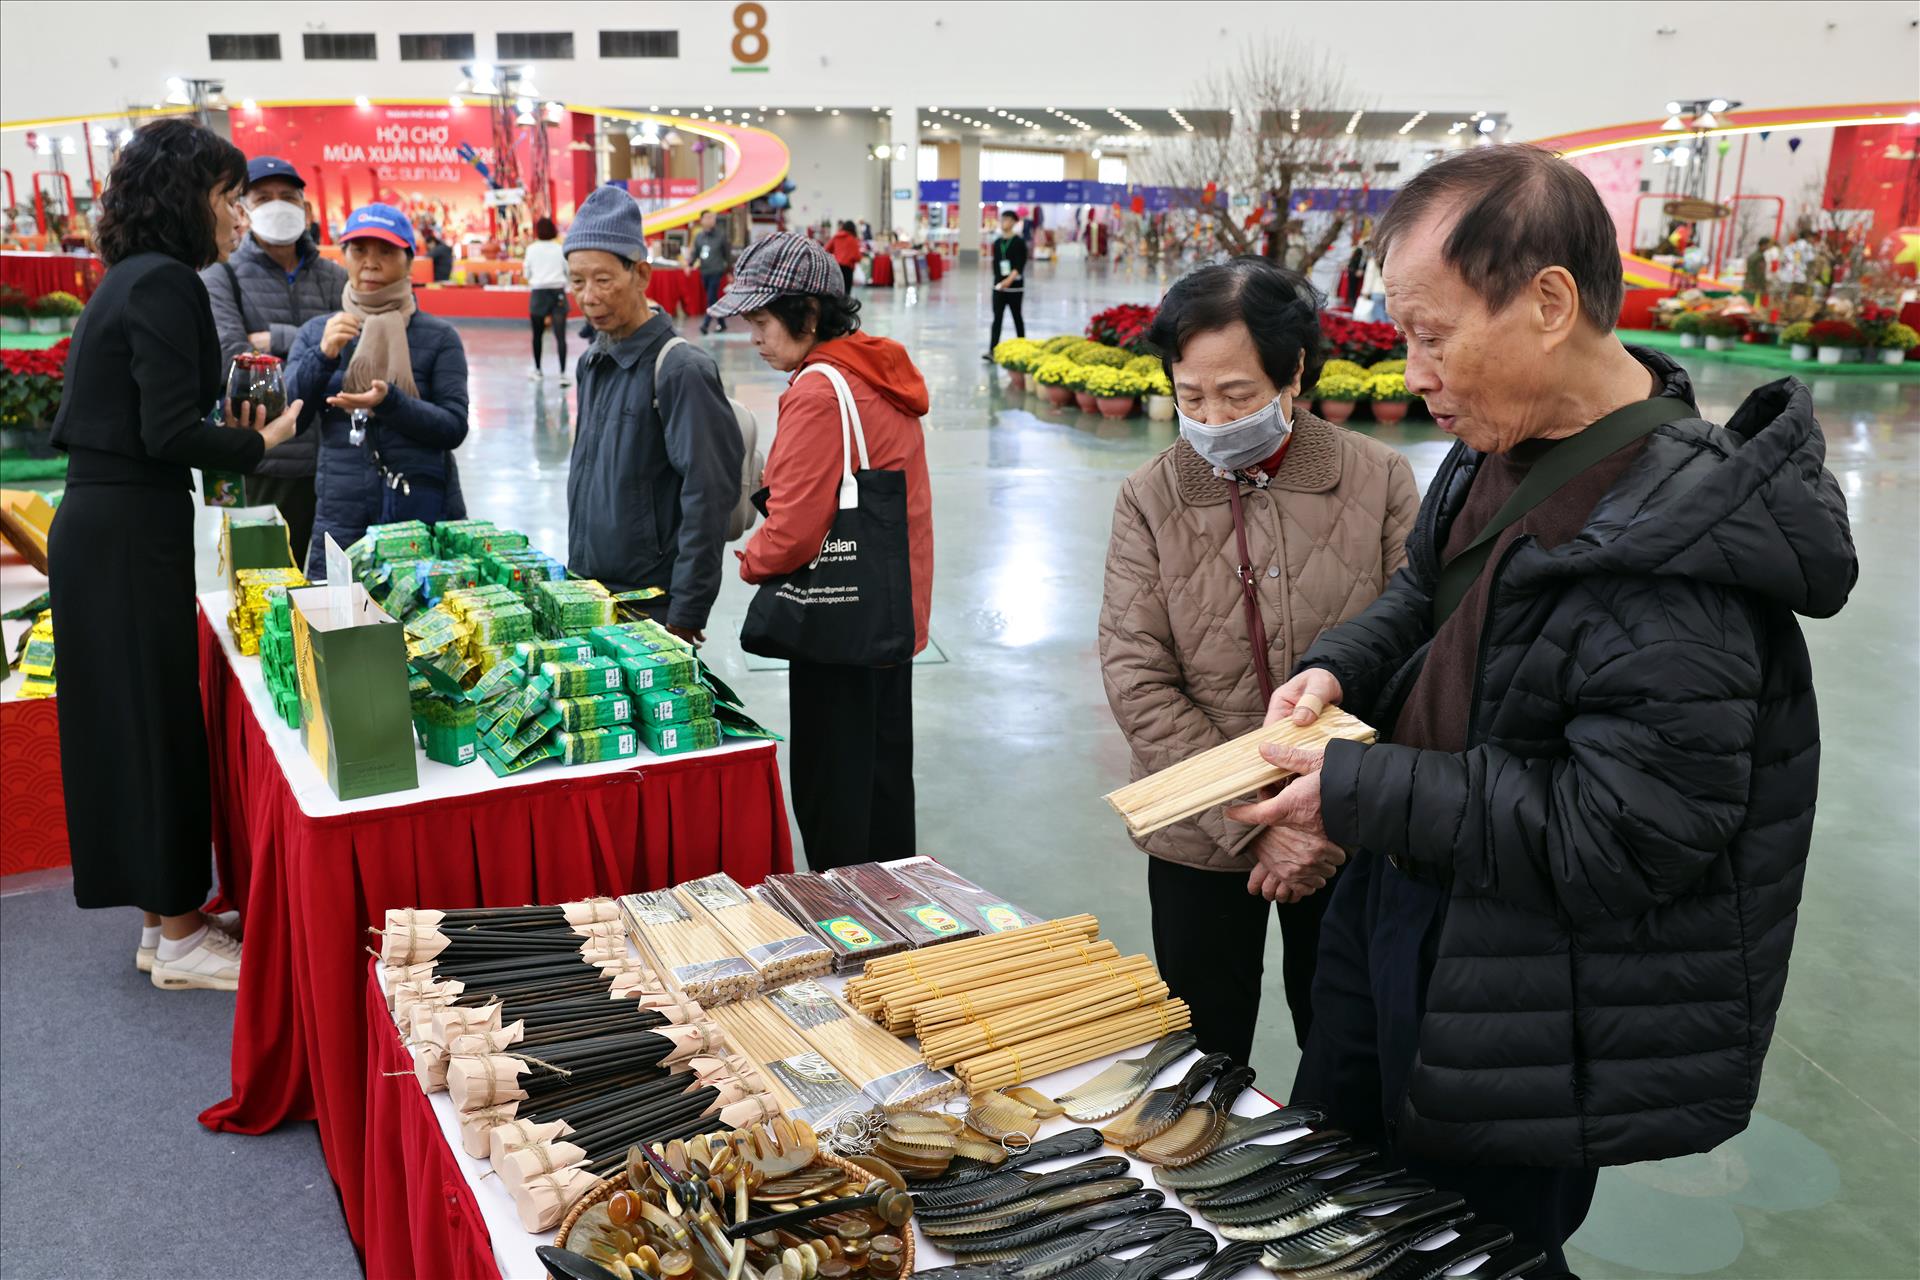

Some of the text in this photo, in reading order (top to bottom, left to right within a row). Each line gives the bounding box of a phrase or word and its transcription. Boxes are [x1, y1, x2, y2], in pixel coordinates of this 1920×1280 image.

[732, 2, 768, 64] 8
[376, 124, 449, 144] HỘI CHỢ
[323, 143, 365, 162] MÙA
[368, 143, 416, 163] XUÂN
[419, 144, 458, 164] NĂM
